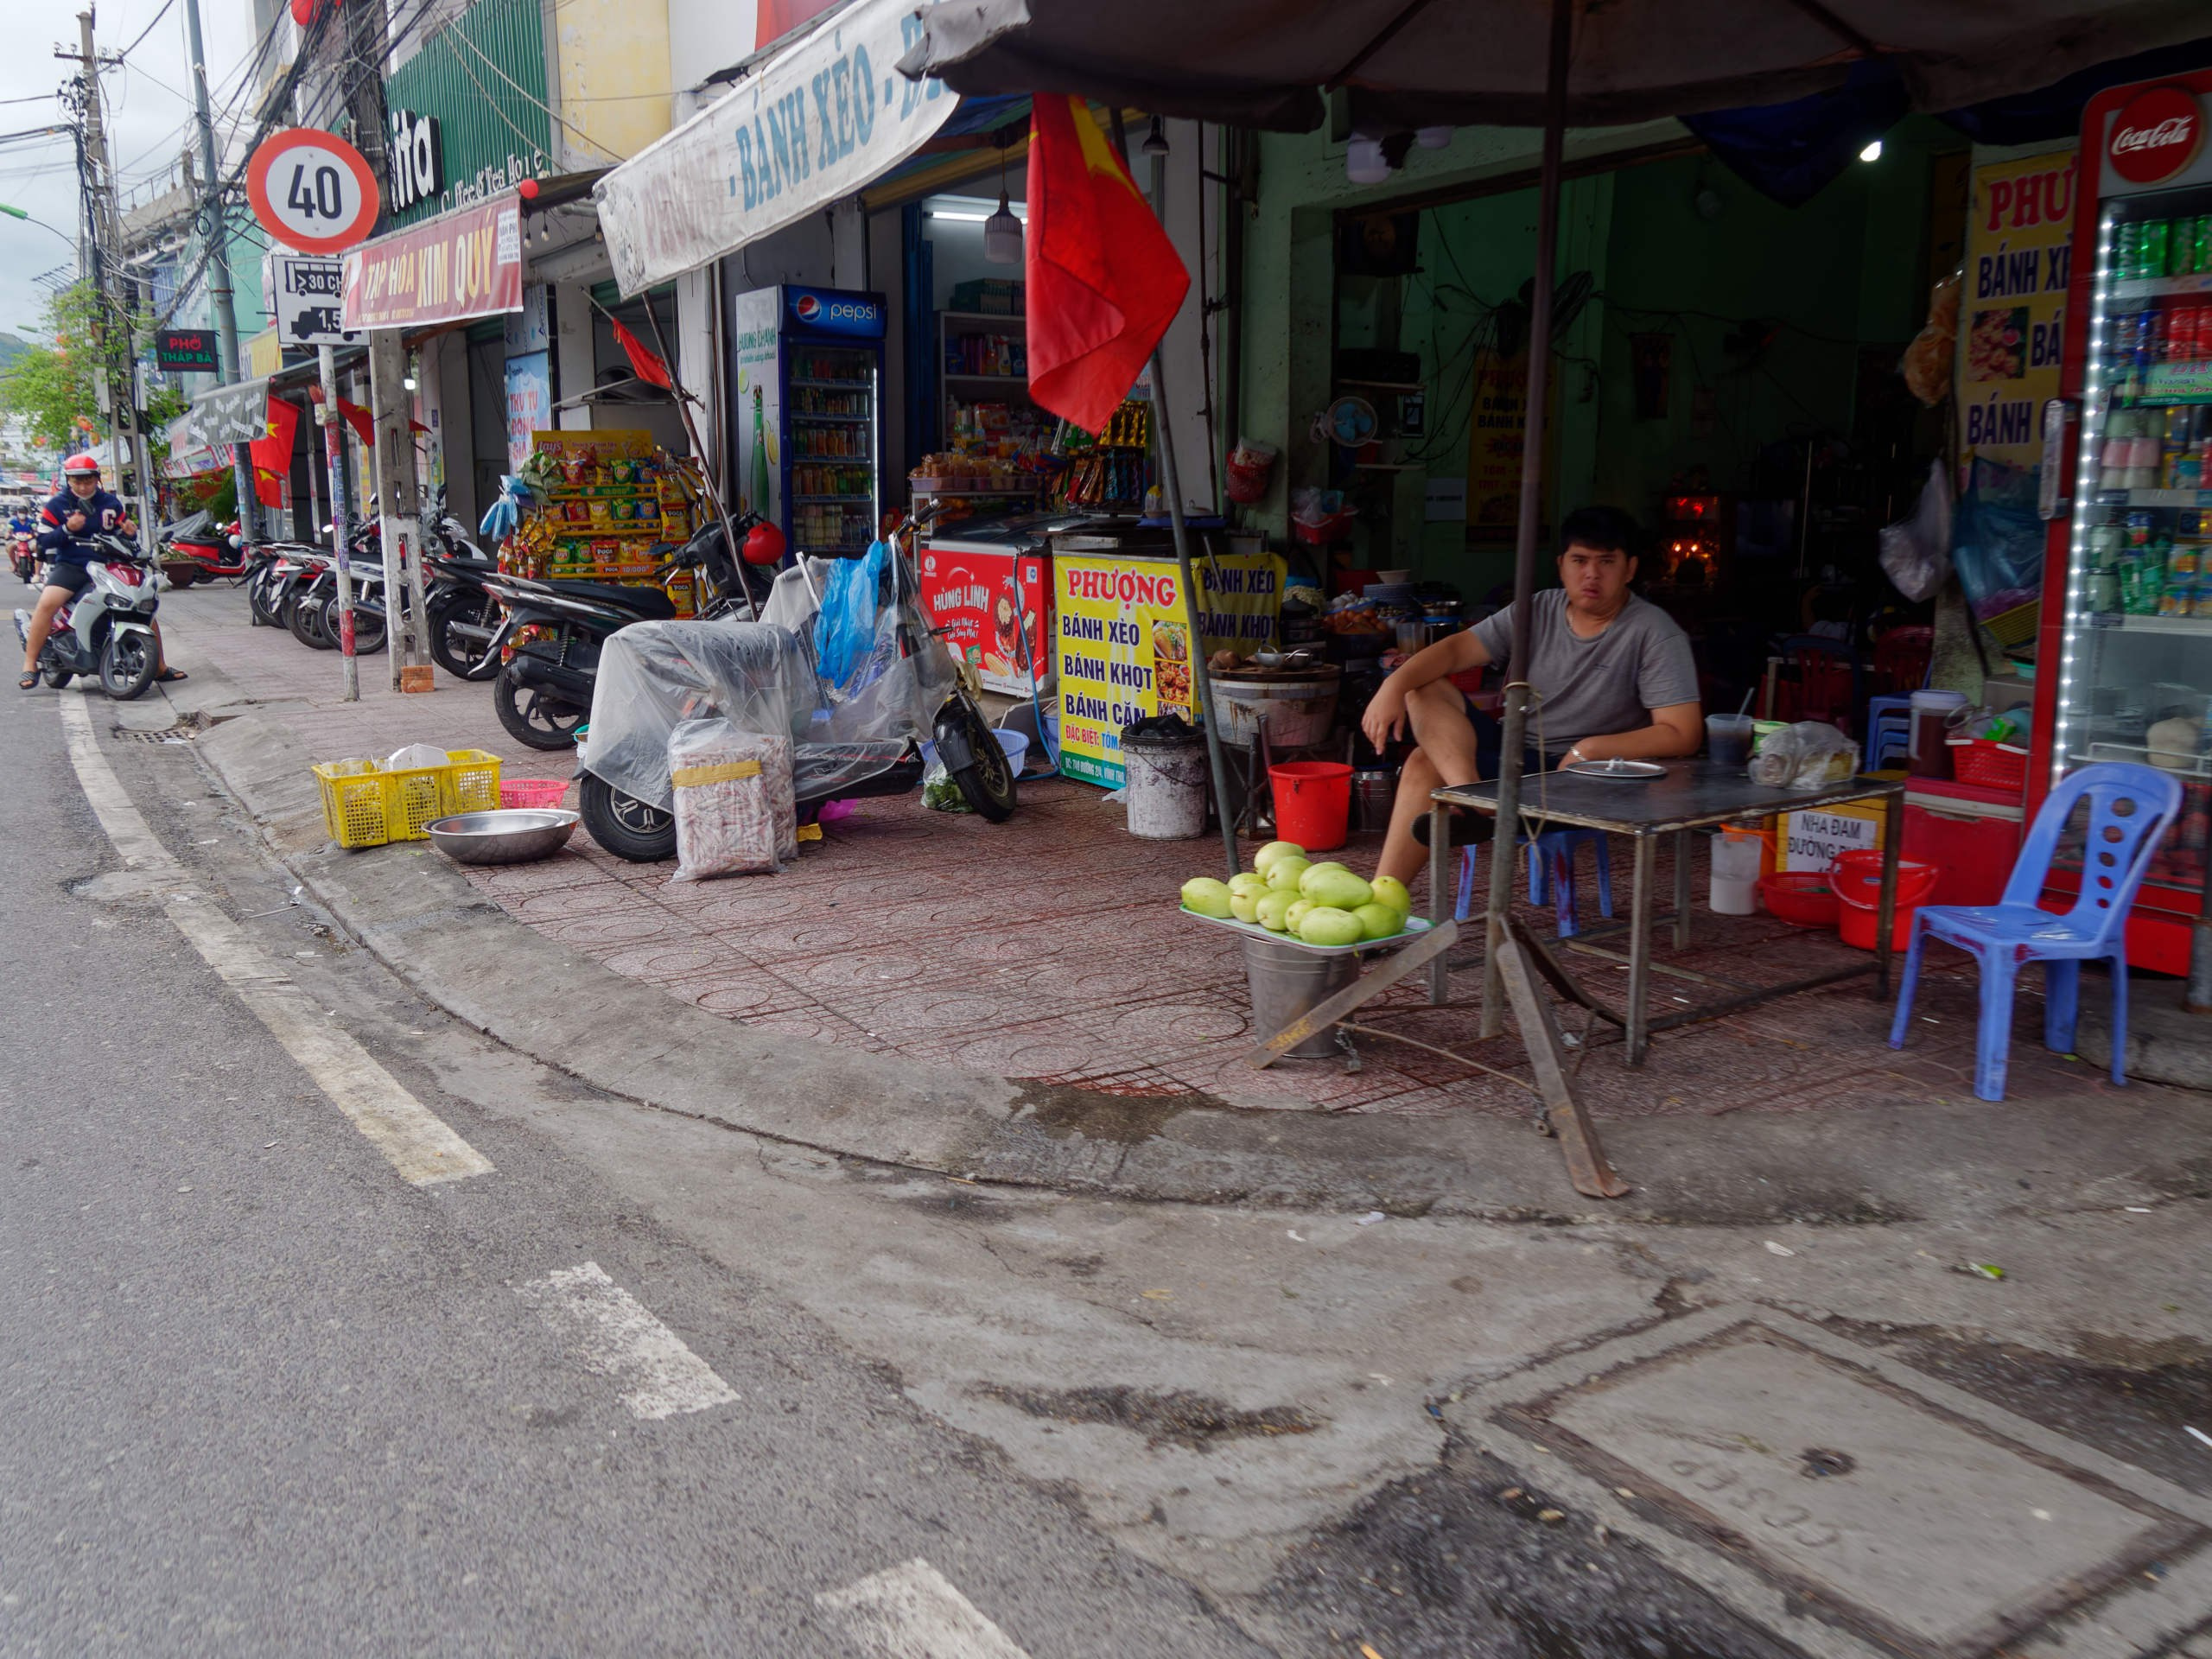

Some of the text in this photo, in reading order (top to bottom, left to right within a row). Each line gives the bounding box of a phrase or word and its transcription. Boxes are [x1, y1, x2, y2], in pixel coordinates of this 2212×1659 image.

[391, 109, 434, 212] ita
[735, 87, 810, 213] BÁNH
[288, 164, 343, 219] 40
[441, 179, 475, 214] Cffee
[1986, 156, 2079, 232] PHƯ
[365, 260, 387, 308] TẠP
[388, 244, 415, 297] HÓA
[416, 240, 449, 308] KIM
[454, 207, 494, 311] QUÝ
[1977, 241, 2039, 299] BÁNH
[308, 275, 325, 290] 30
[327, 276, 342, 290] CH
[830, 302, 877, 322] pepsi
[168, 334, 202, 350] PHỞ
[2031, 308, 2062, 366] BÁ
[162, 351, 194, 364] THÁP
[1967, 396, 2032, 446] BÁNH
[933, 587, 962, 612] HÙNG
[1068, 568, 1176, 610] PHƯỢNG
[1063, 612, 1140, 646] BÁNH XÈO
[1065, 652, 1153, 693] BÁNH KHỌT
[1065, 692, 1146, 727] BÁNH CĂN
[1065, 722, 1080, 744] ĐẶC
[1801, 813, 1828, 835] NHA
